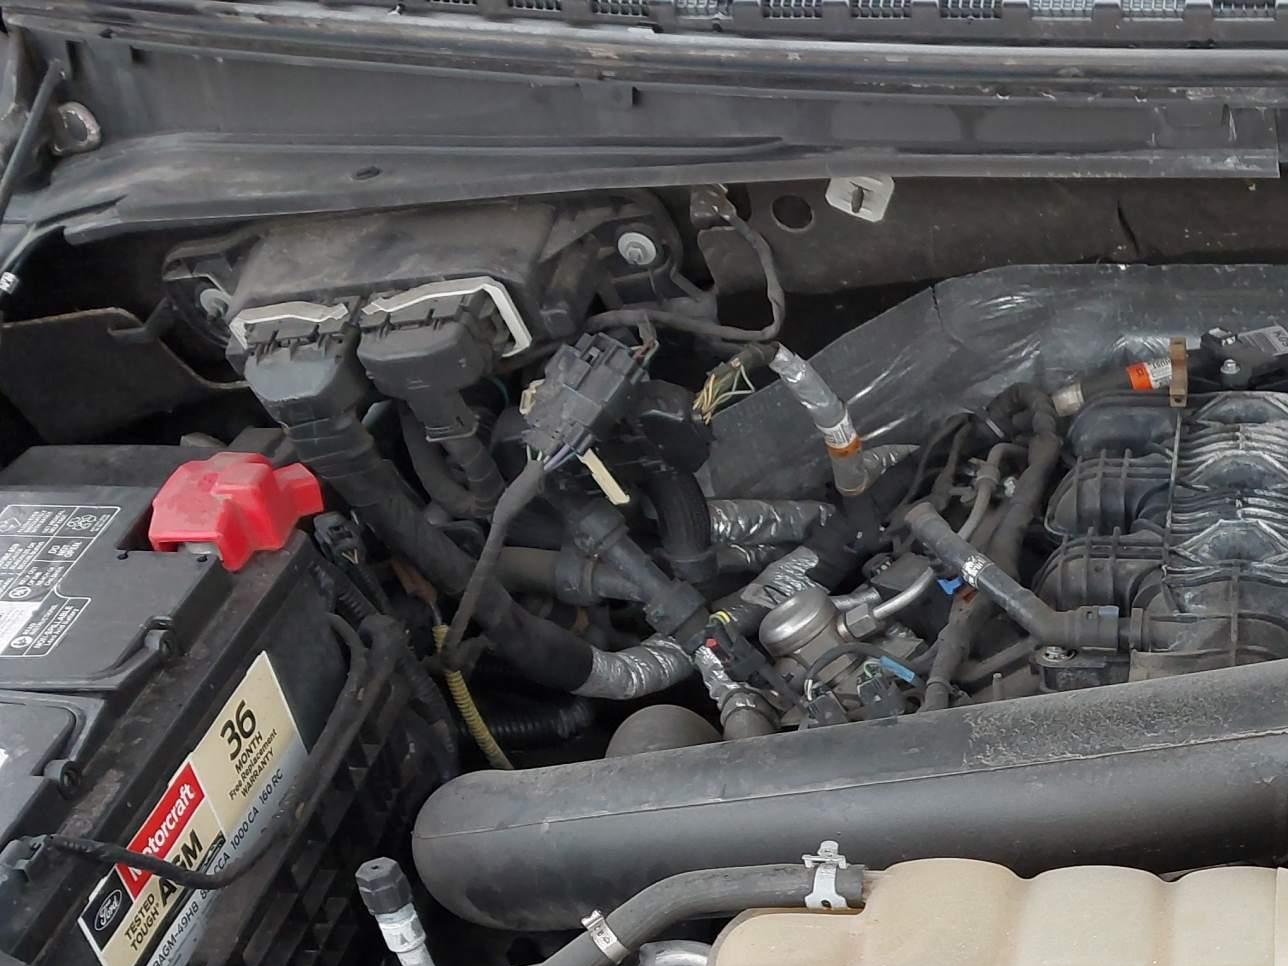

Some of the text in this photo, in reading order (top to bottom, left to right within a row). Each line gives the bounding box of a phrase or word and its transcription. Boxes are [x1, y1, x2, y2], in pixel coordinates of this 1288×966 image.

[220, 699, 256, 761] 36
[235, 731, 263, 774] MONTH
[229, 728, 278, 801] Free Replacement
[241, 747, 274, 798] WARRANTY
[230, 822, 249, 850] 1000
[247, 806, 260, 824] CA
[271, 768, 284, 788] RC
[100, 894, 119, 926] Ford
[124, 893, 155, 941] TESTED
